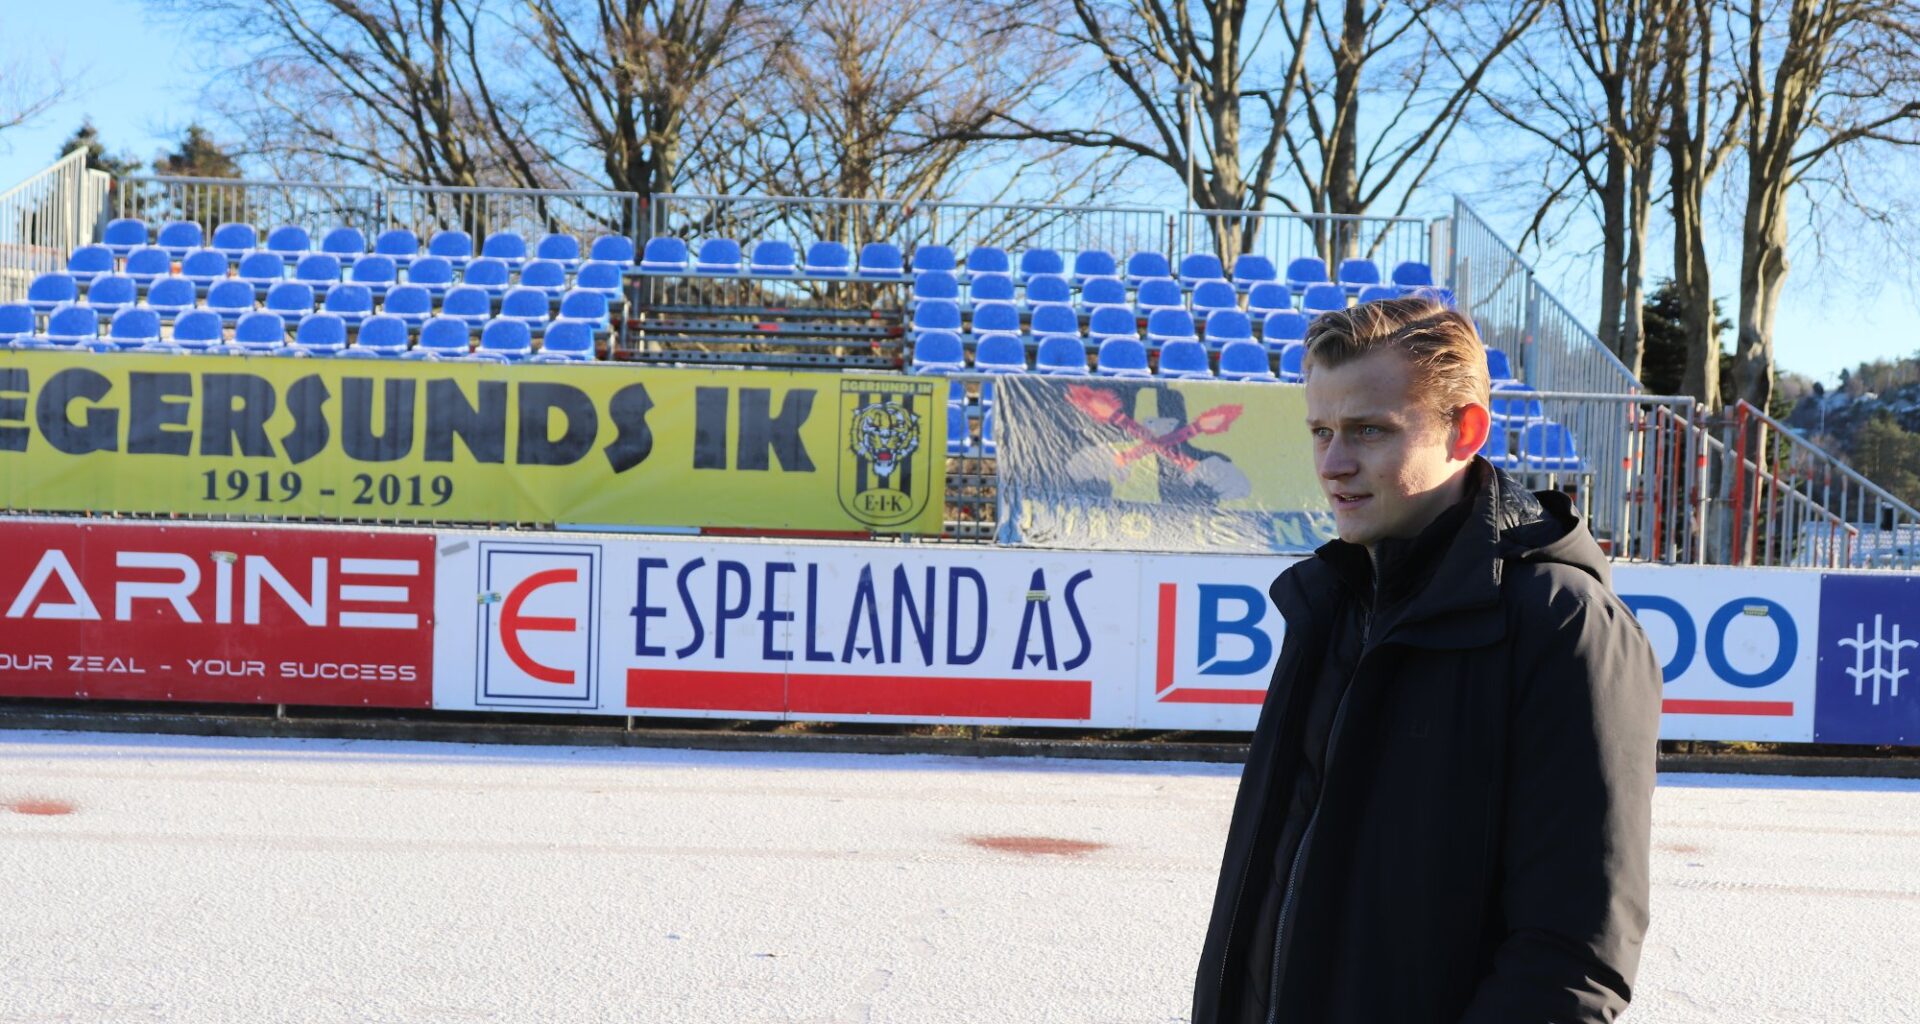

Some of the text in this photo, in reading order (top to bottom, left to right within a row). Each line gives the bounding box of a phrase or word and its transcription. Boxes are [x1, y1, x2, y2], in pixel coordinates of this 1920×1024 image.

[693, 386, 818, 472] IK
[201, 470, 302, 502] 1919
[352, 473, 454, 506] 2019
[630, 556, 988, 667] ESPELAND
[1012, 567, 1093, 671] AS
[67, 655, 146, 673] ZEAL
[186, 659, 265, 677] YOUR
[279, 662, 417, 681] SUCCESS
